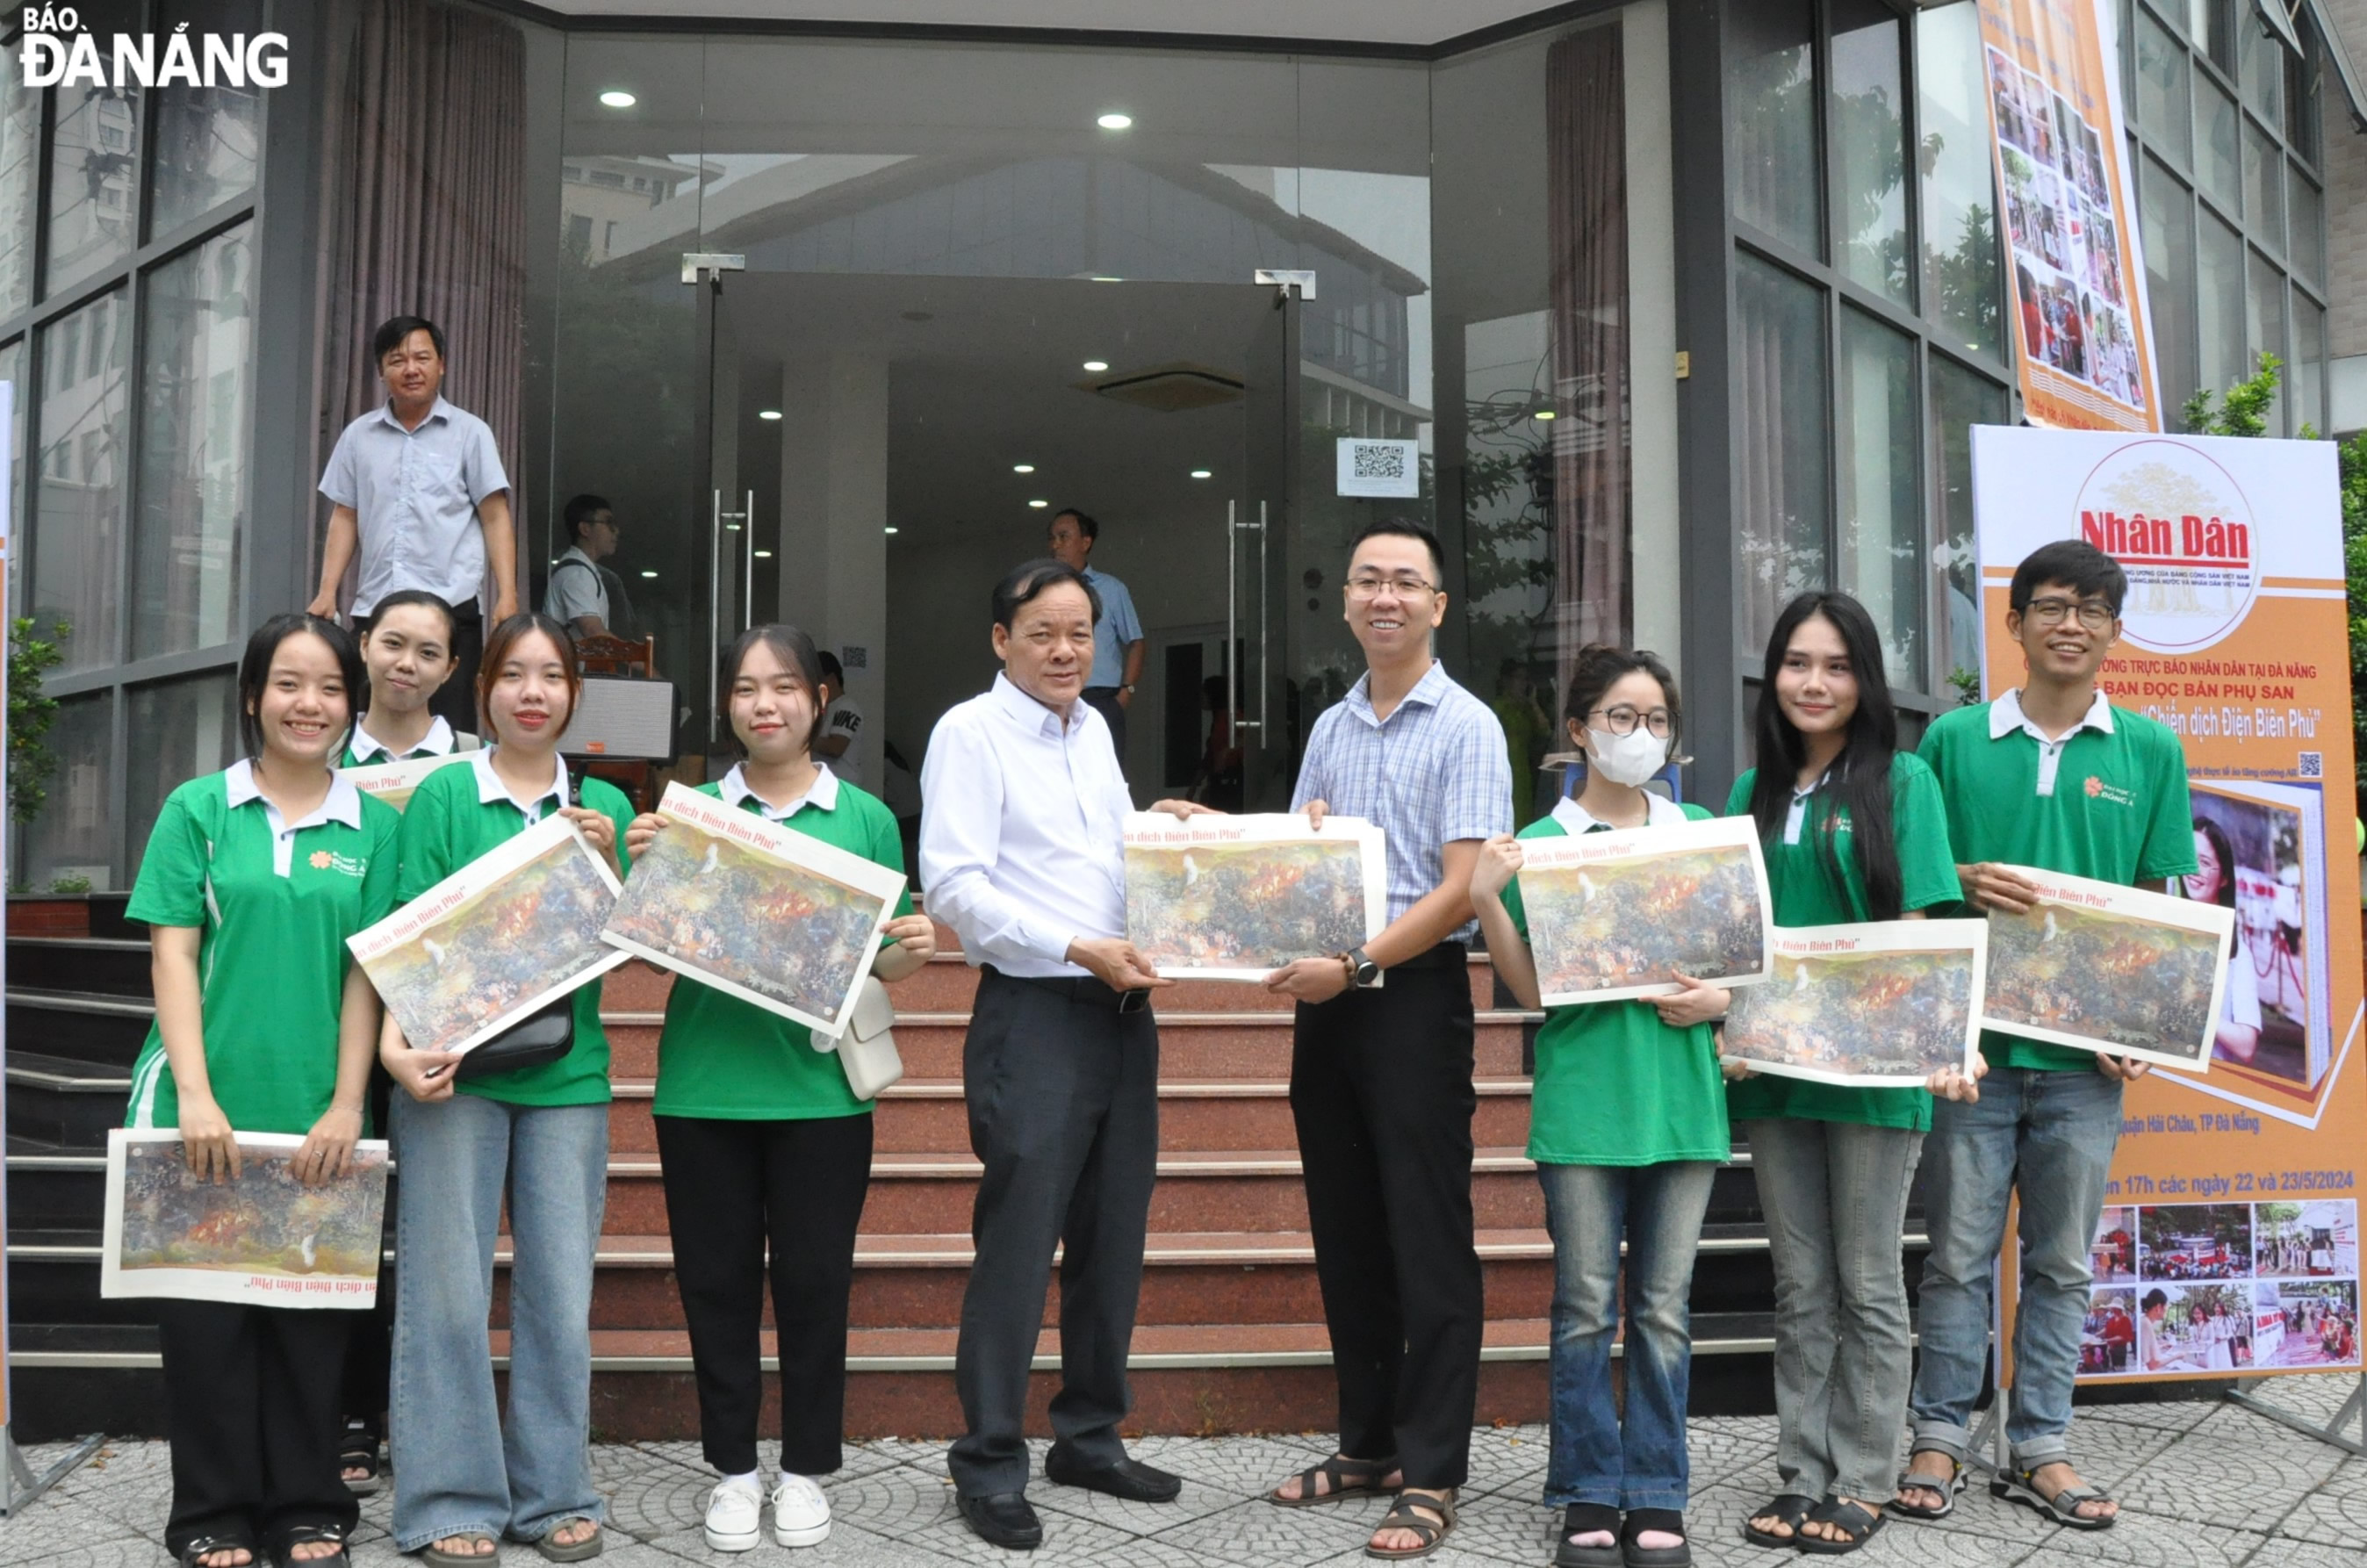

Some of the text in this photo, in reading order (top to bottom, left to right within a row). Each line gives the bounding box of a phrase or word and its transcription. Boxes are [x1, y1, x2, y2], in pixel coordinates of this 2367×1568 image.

[2082, 511, 2249, 558] Nhân Dân
[2130, 659, 2160, 677] TRỰC
[2164, 658, 2187, 674] BÁO
[2191, 659, 2220, 676] NHÂN
[2223, 660, 2246, 676] DÂN
[2248, 664, 2265, 680] TẠI
[2268, 662, 2284, 678] ĐÀ
[2104, 681, 2138, 698] BẠN
[2143, 682, 2179, 700] ĐỌC
[2184, 680, 2218, 697] BẢN
[2224, 684, 2256, 701] PHỤ
[2262, 685, 2294, 700] SAN
[833, 709, 861, 732] NIKE
[2190, 706, 2219, 744] dịch
[2221, 706, 2252, 744] Điện
[2255, 708, 2285, 737] Biên
[2199, 1113, 2213, 1131] TP
[2215, 1112, 2229, 1132] Đà
[2126, 1176, 2154, 1194] 17h
[2159, 1174, 2186, 1194] các
[2191, 1173, 2230, 1197] ngày
[2235, 1172, 2254, 1191] 22
[2258, 1172, 2277, 1190] và
[2281, 1170, 2354, 1190] 23/5/2024
